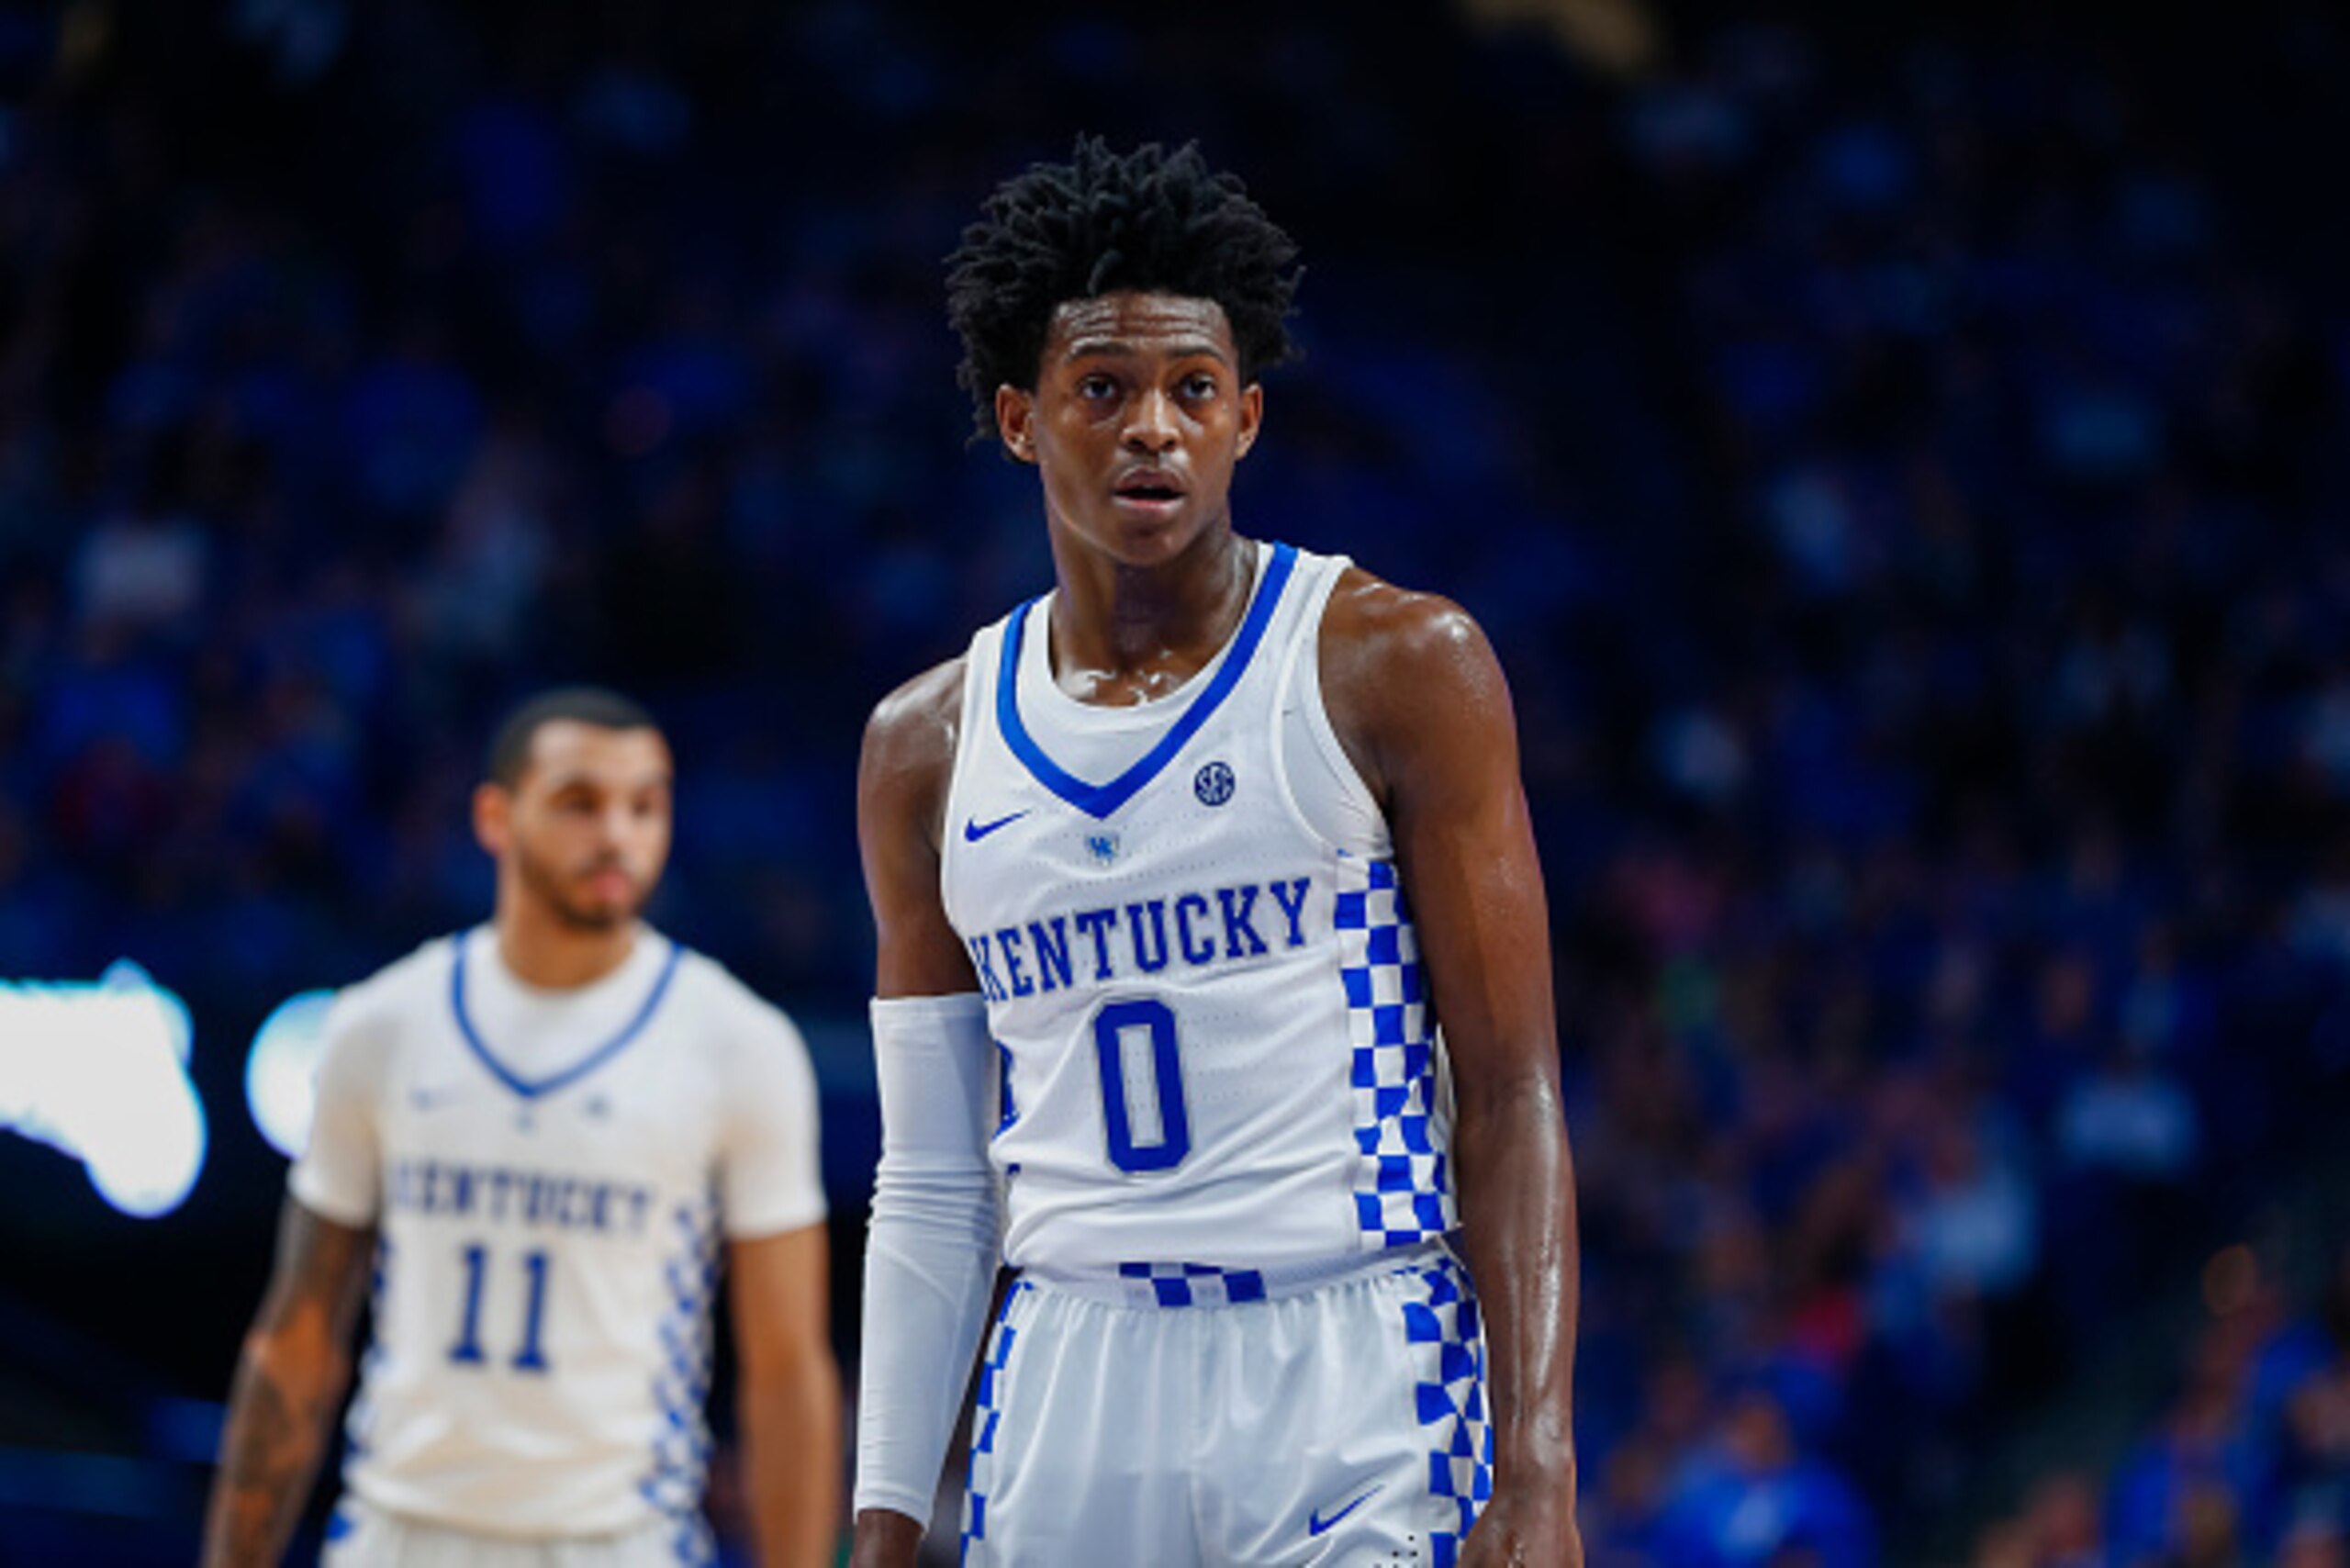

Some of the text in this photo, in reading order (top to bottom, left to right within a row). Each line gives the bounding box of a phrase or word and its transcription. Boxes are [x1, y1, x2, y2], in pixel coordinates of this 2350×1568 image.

[969, 877, 1312, 1003] KENTUCKY
[1095, 999, 1192, 1173] 0
[446, 1243, 553, 1373] 11
